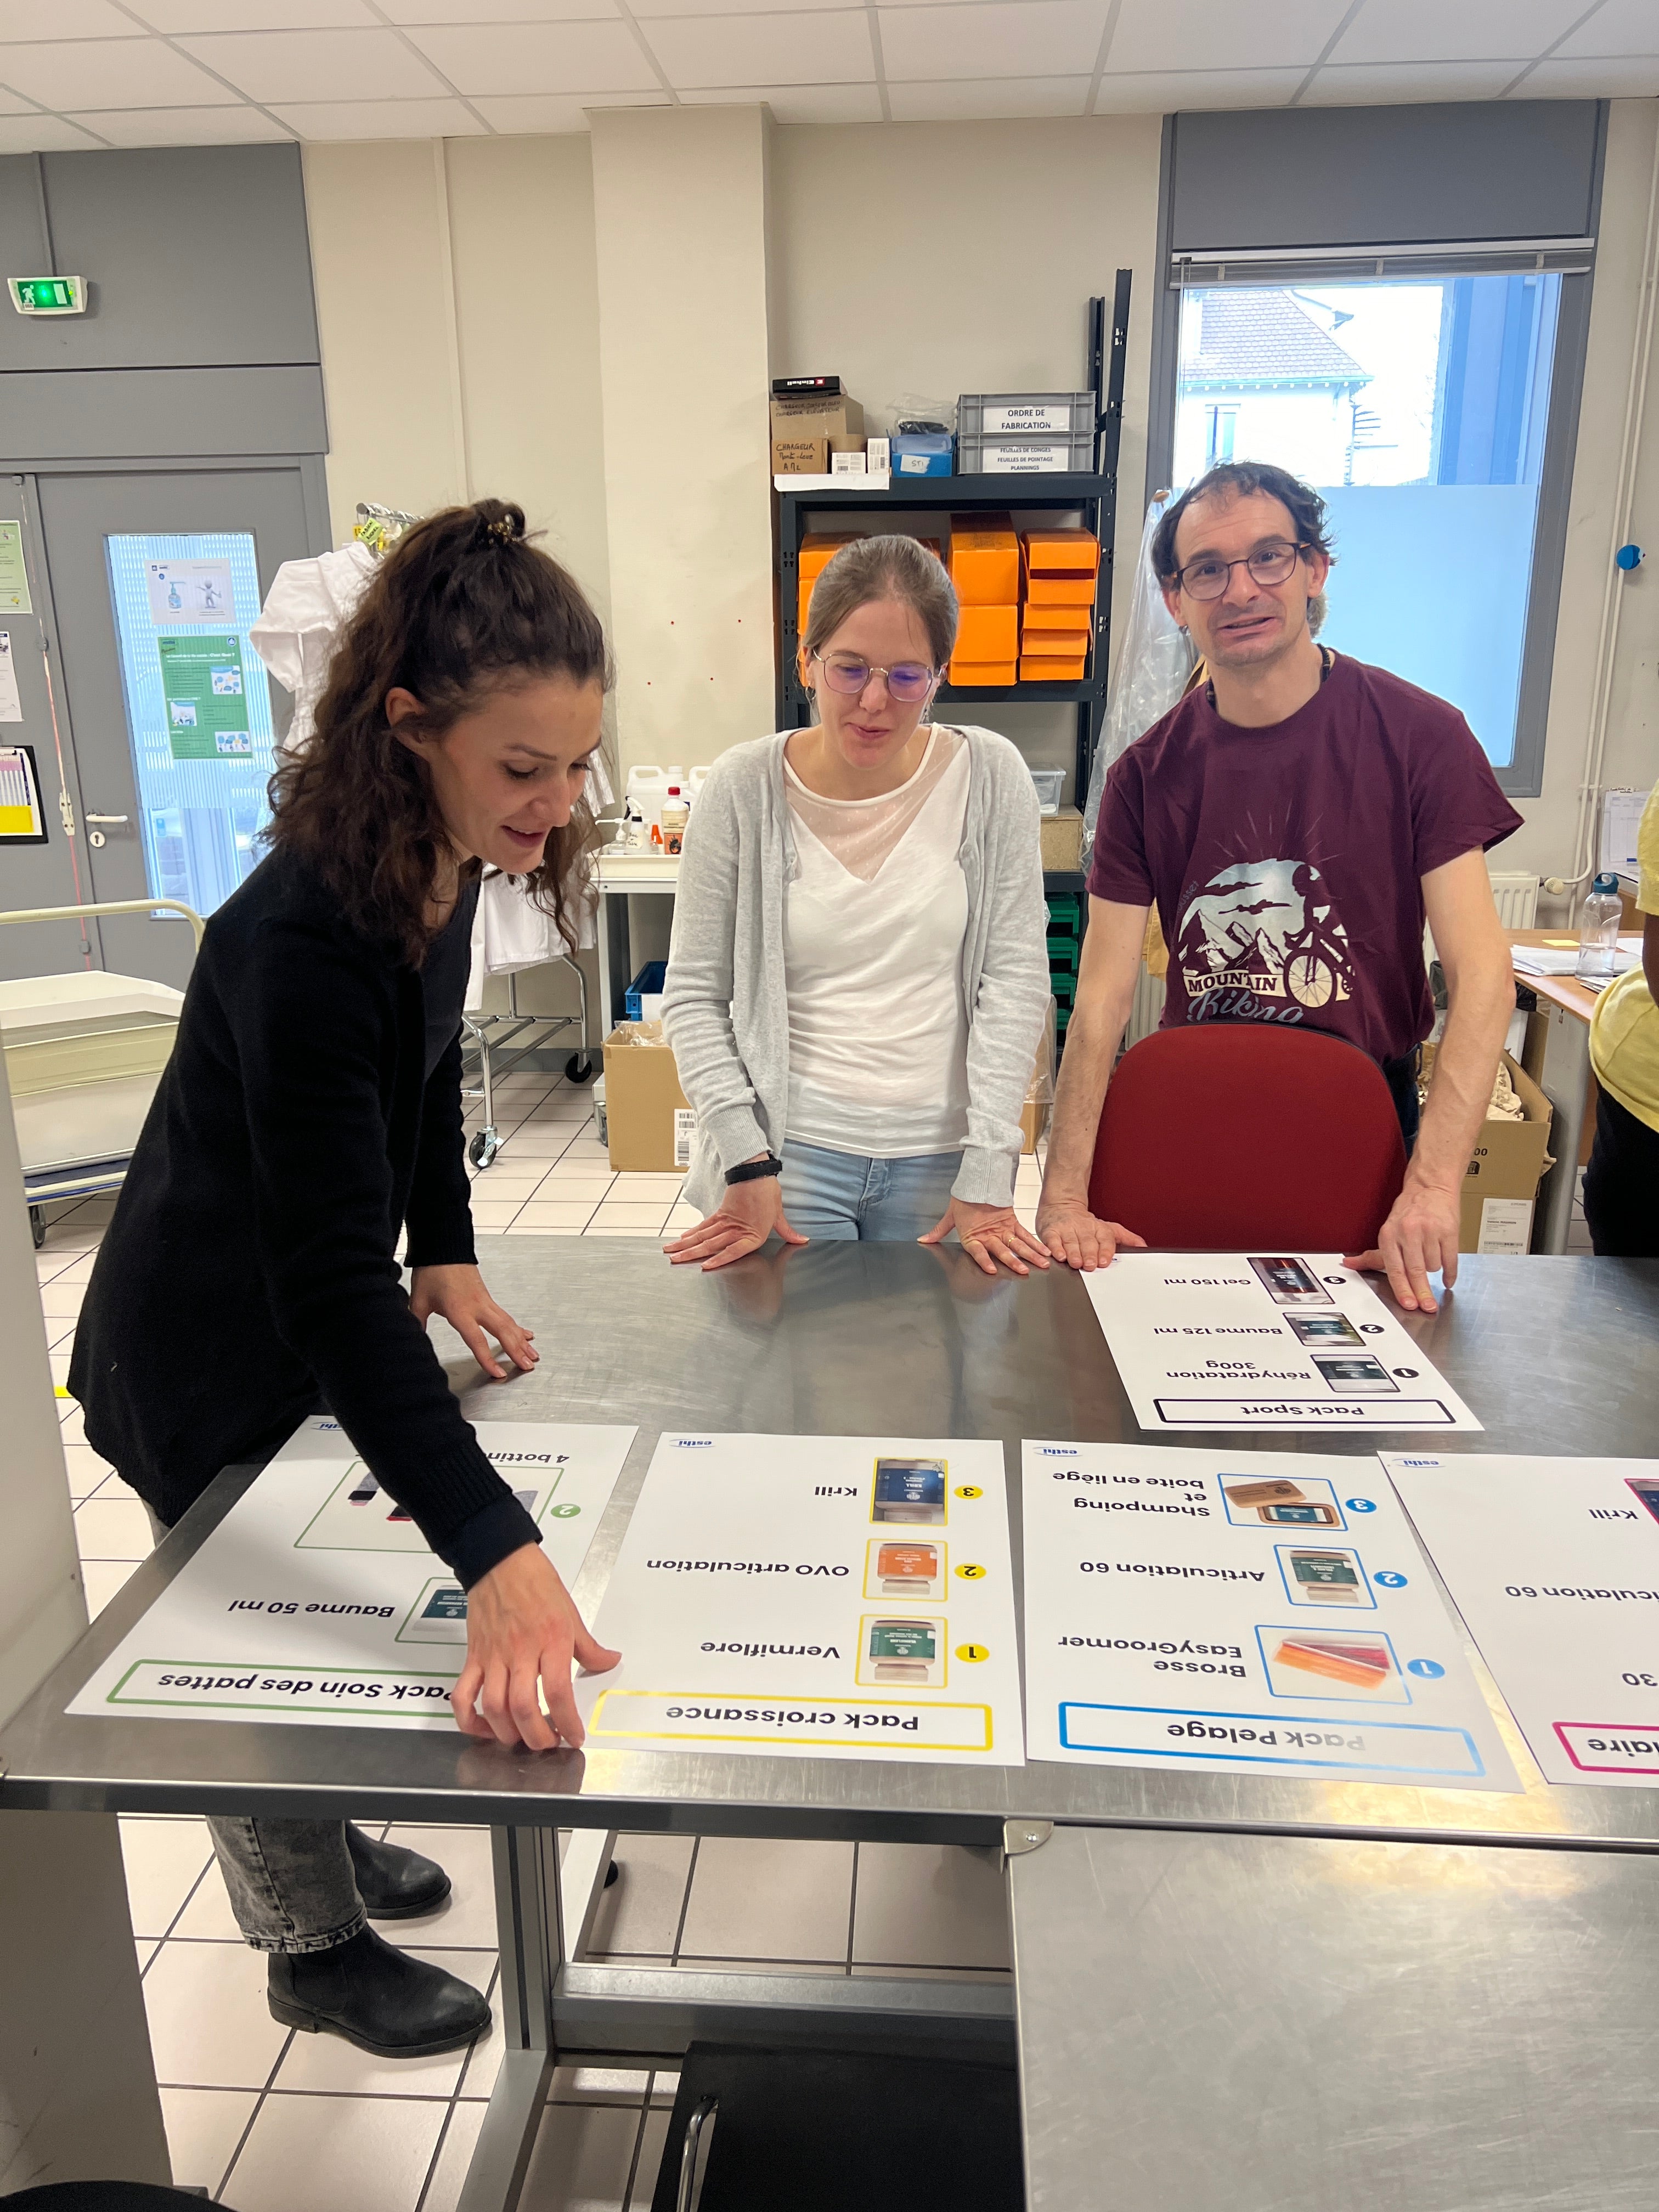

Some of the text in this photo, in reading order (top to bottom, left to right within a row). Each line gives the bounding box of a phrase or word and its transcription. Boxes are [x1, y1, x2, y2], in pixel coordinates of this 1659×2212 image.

[776, 443, 816, 451] CHARGEUR
[1206, 1361, 1255, 1369] 300g
[1166, 1370, 1311, 1379] Réhydratation
[1241, 1405, 1302, 1414] Sport
[486, 1452, 552, 1463] bottin
[1053, 1471, 1106, 1484] liège
[1146, 1479, 1204, 1489] boite
[815, 1487, 857, 1496] Krill
[963, 1488, 974, 1496] 3
[560, 1505, 574, 1515] 2
[1075, 1498, 1210, 1516] Shampoing
[1354, 1500, 1368, 1509] 3
[1589, 1510, 1638, 1519] Krill
[647, 1561, 849, 1576] OVO articulation
[964, 1566, 976, 1576] 2
[1080, 1562, 1264, 1581] Articulation 60
[1382, 1573, 1398, 1584] 2
[1505, 1587, 1537, 1597] 60
[228, 1601, 395, 1617] Baume 50 ml
[701, 1643, 839, 1658] Vermiflore
[969, 1647, 977, 1658] 1
[1058, 1637, 1242, 1658] EasyGroomer
[1154, 1661, 1246, 1677] Brosse
[1420, 1662, 1432, 1674] 1
[159, 1674, 258, 1690] pattes
[1622, 1673, 1657, 1686] 30
[261, 1680, 313, 1694] des
[320, 1683, 383, 1697] Soin
[667, 1708, 918, 1730] Pack croissance
[1167, 1721, 1366, 1750] Pack Pelage
